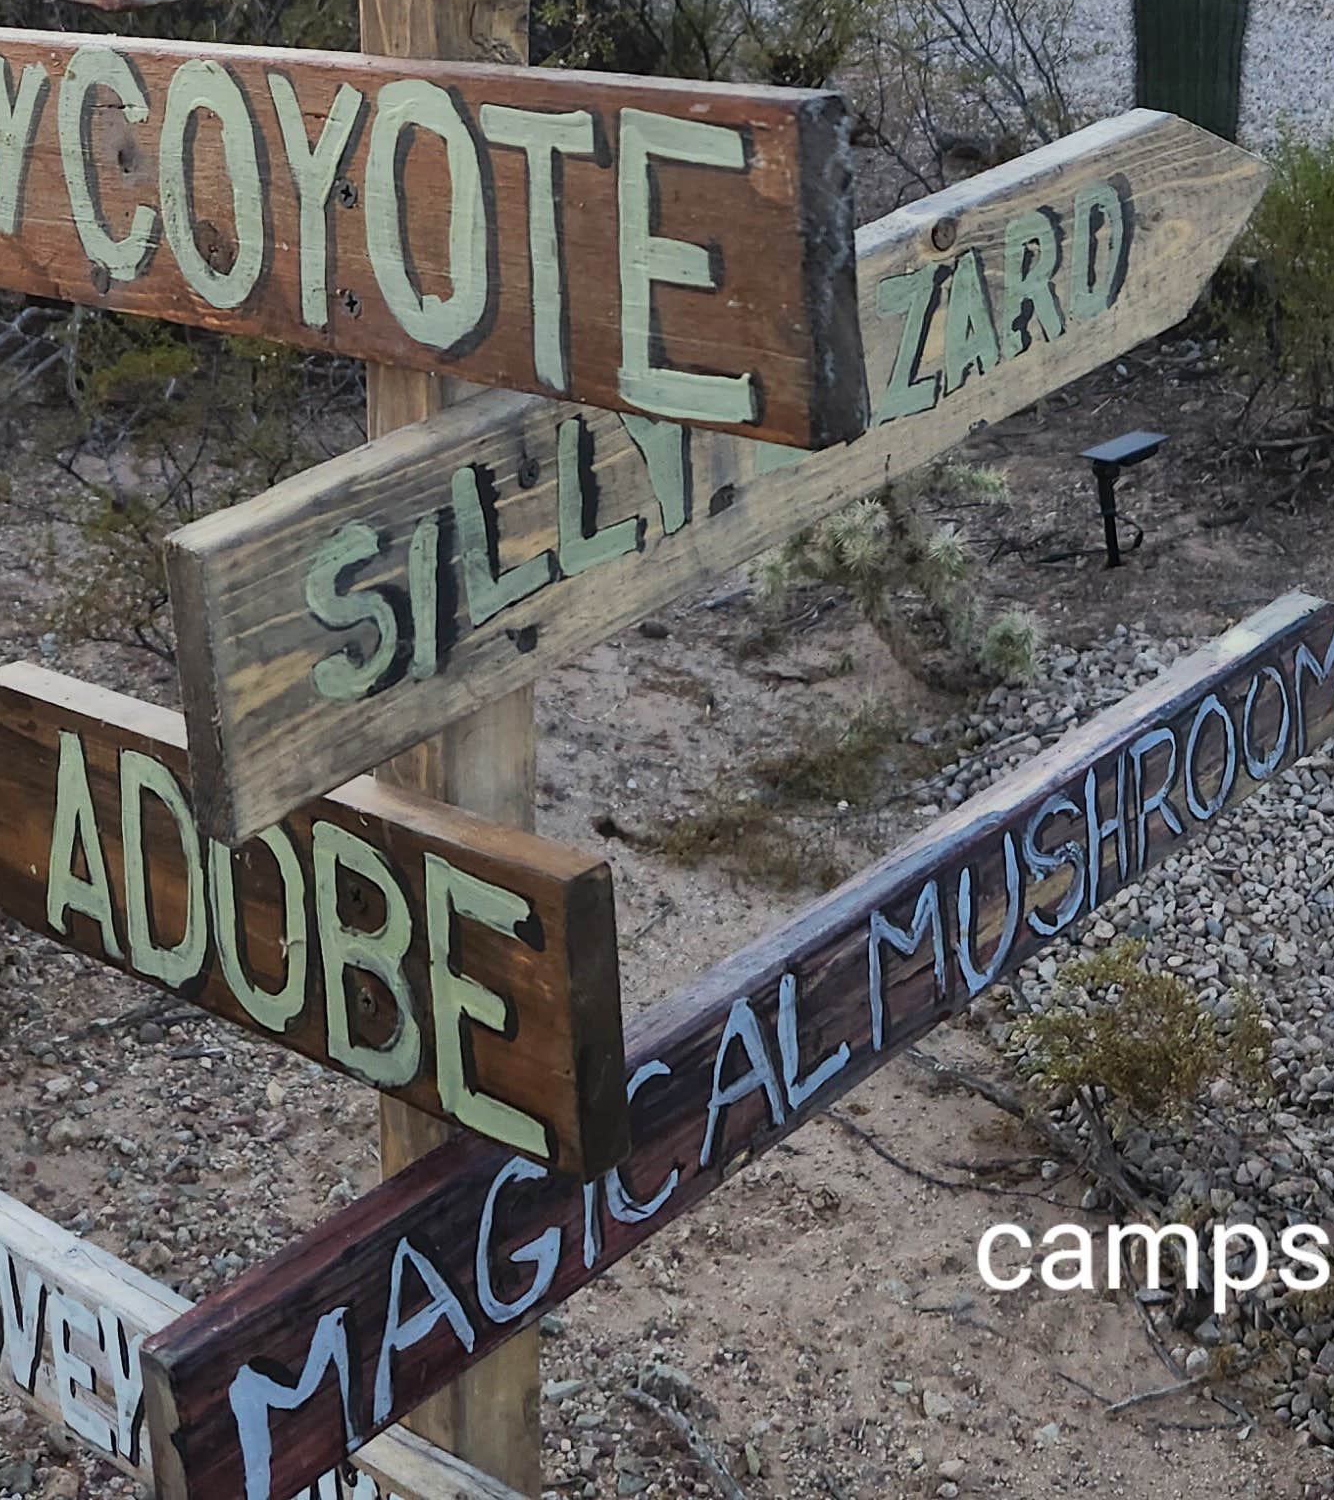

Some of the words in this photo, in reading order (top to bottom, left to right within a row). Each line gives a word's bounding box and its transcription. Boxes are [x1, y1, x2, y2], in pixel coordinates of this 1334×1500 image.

[63, 45, 761, 425] COYOTE
[46, 730, 555, 1160] ADOBE
[228, 974, 851, 1500] MAGICAL
